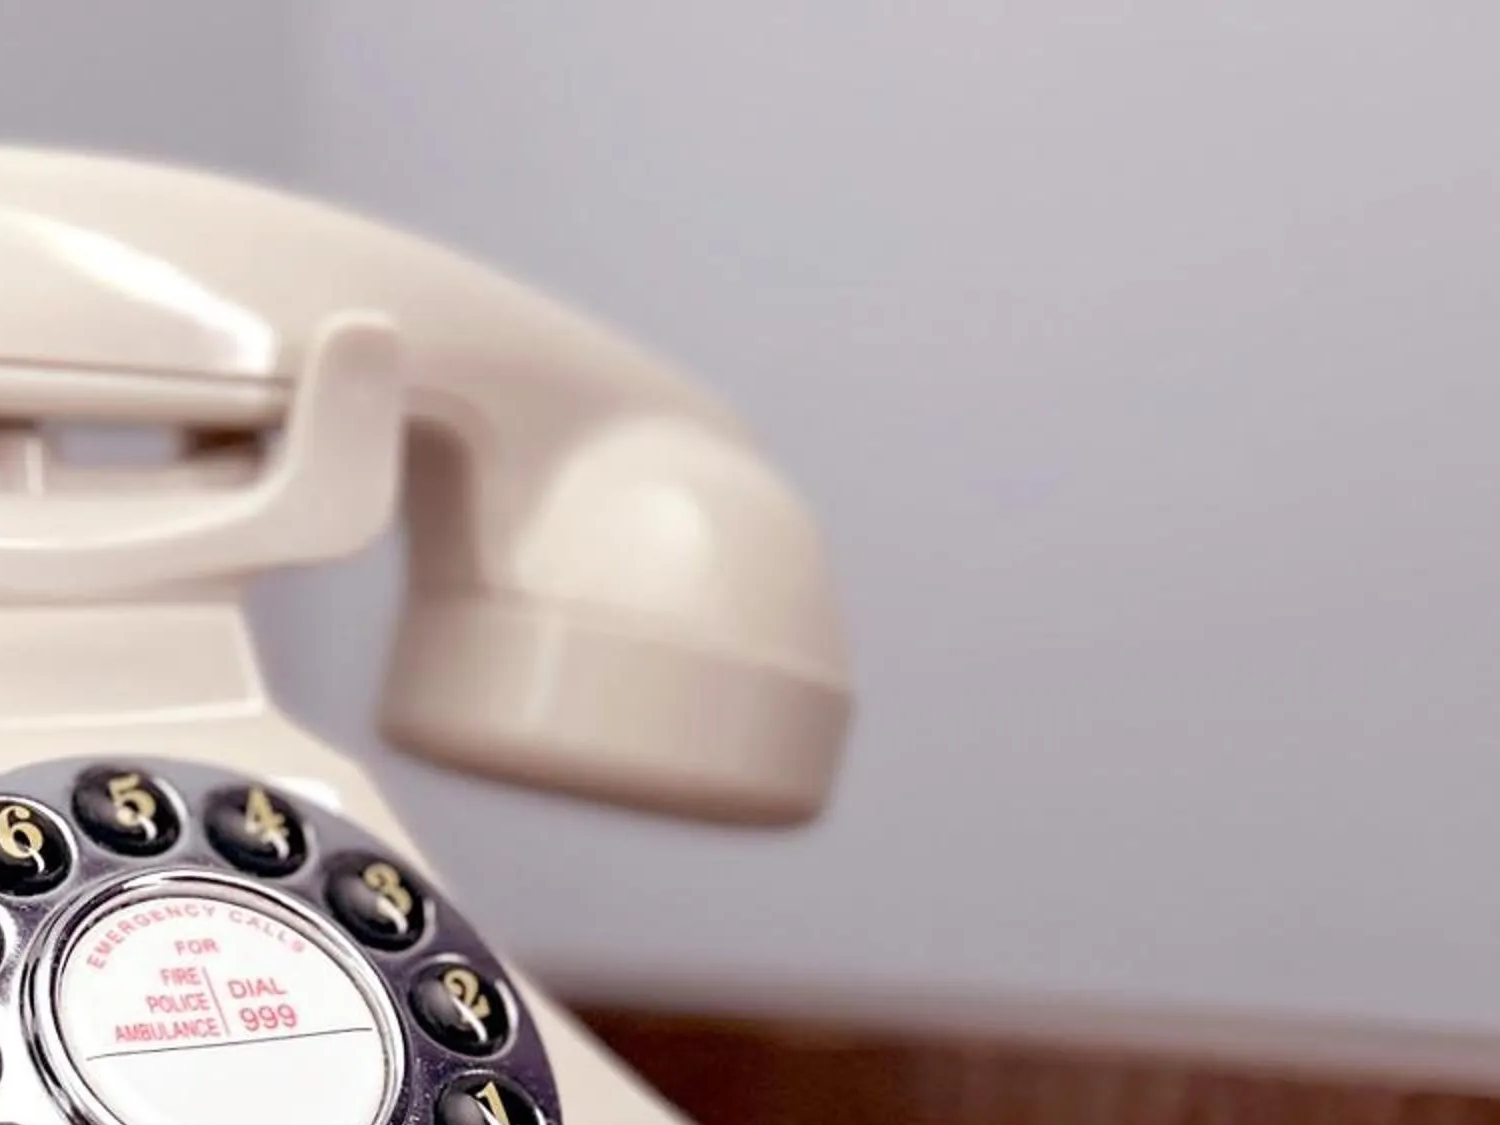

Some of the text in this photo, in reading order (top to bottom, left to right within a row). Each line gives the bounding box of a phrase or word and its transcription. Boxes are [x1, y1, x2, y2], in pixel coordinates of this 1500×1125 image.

[106, 773, 156, 828] 5
[245, 788, 289, 842] 4
[363, 864, 411, 916] 3
[87, 903, 215, 969] EMERGENCY
[174, 938, 219, 954] FOR
[160, 966, 201, 986] FIRE
[228, 978, 287, 999] DIAL
[146, 994, 209, 1013] POLICE
[444, 969, 496, 1026] 2
[115, 1018, 221, 1042] AMBULANCE
[239, 1004, 296, 1031] 999
